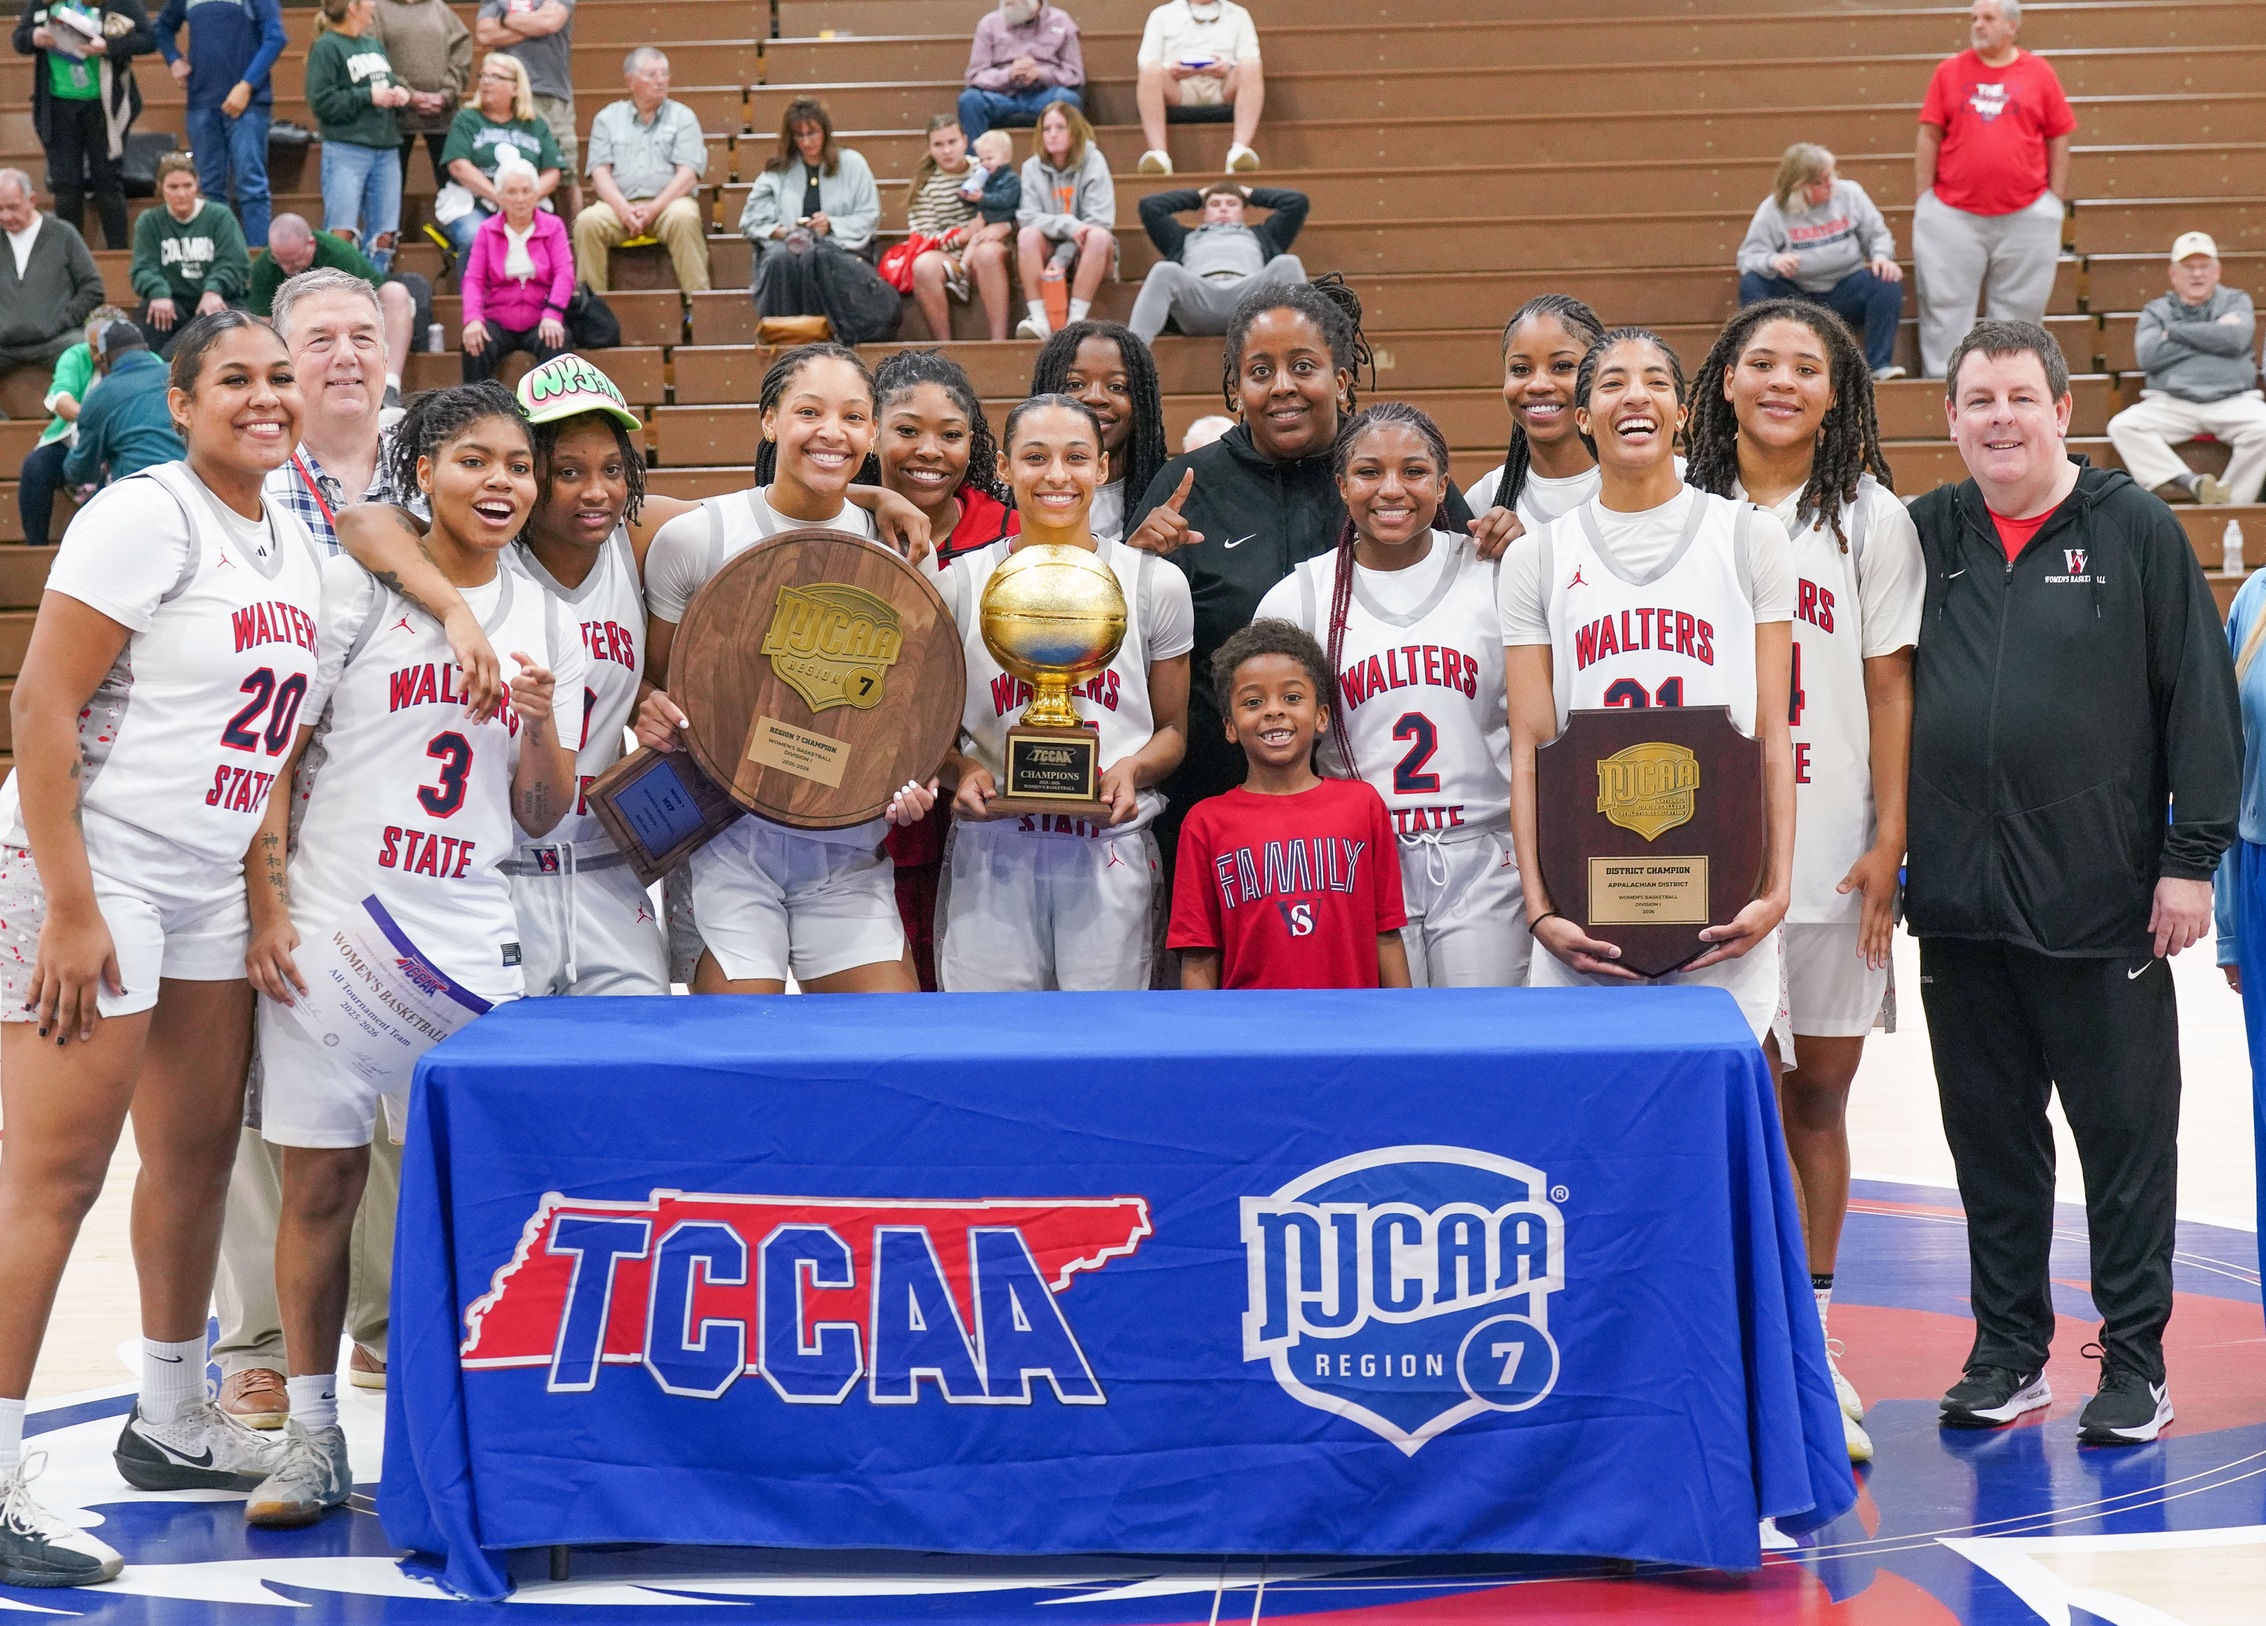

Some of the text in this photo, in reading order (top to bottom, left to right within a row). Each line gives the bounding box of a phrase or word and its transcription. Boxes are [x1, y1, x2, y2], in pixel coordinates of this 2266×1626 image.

[768, 594, 898, 660] NJCAA
[1575, 607, 1714, 671] WALTERS
[787, 658, 874, 696] REGION 7
[1340, 645, 1479, 711] WALTERS
[219, 666, 308, 757] 20
[767, 737, 832, 763] WOMEN'S BASKETBALL
[768, 726, 838, 754] REGION 7 CHAMPION
[781, 758, 810, 772] 2025-2026
[784, 749, 810, 763] DIVISION
[1032, 748, 1073, 764] TCCAA
[1392, 711, 1441, 795] 2
[416, 730, 474, 820] 3
[1020, 770, 1080, 780] CHAMPIONS
[1602, 763, 1694, 807] NJCAA
[378, 825, 476, 880] STATE
[1216, 837, 1366, 909] FAMILY
[1606, 866, 1691, 875] DISTRICT CHAMPION
[329, 968, 343, 984] All
[342, 982, 391, 1031] Tournament
[389, 1028, 411, 1047] Team
[332, 931, 384, 993] WOMEN'S
[379, 989, 449, 1044] BASKETBALL
[340, 1001, 380, 1038] 2025-2026
[1257, 1211, 1549, 1342] NJCAA
[545, 1213, 1108, 1406] TCCAA
[1315, 1341, 1525, 1386] REGION 7
